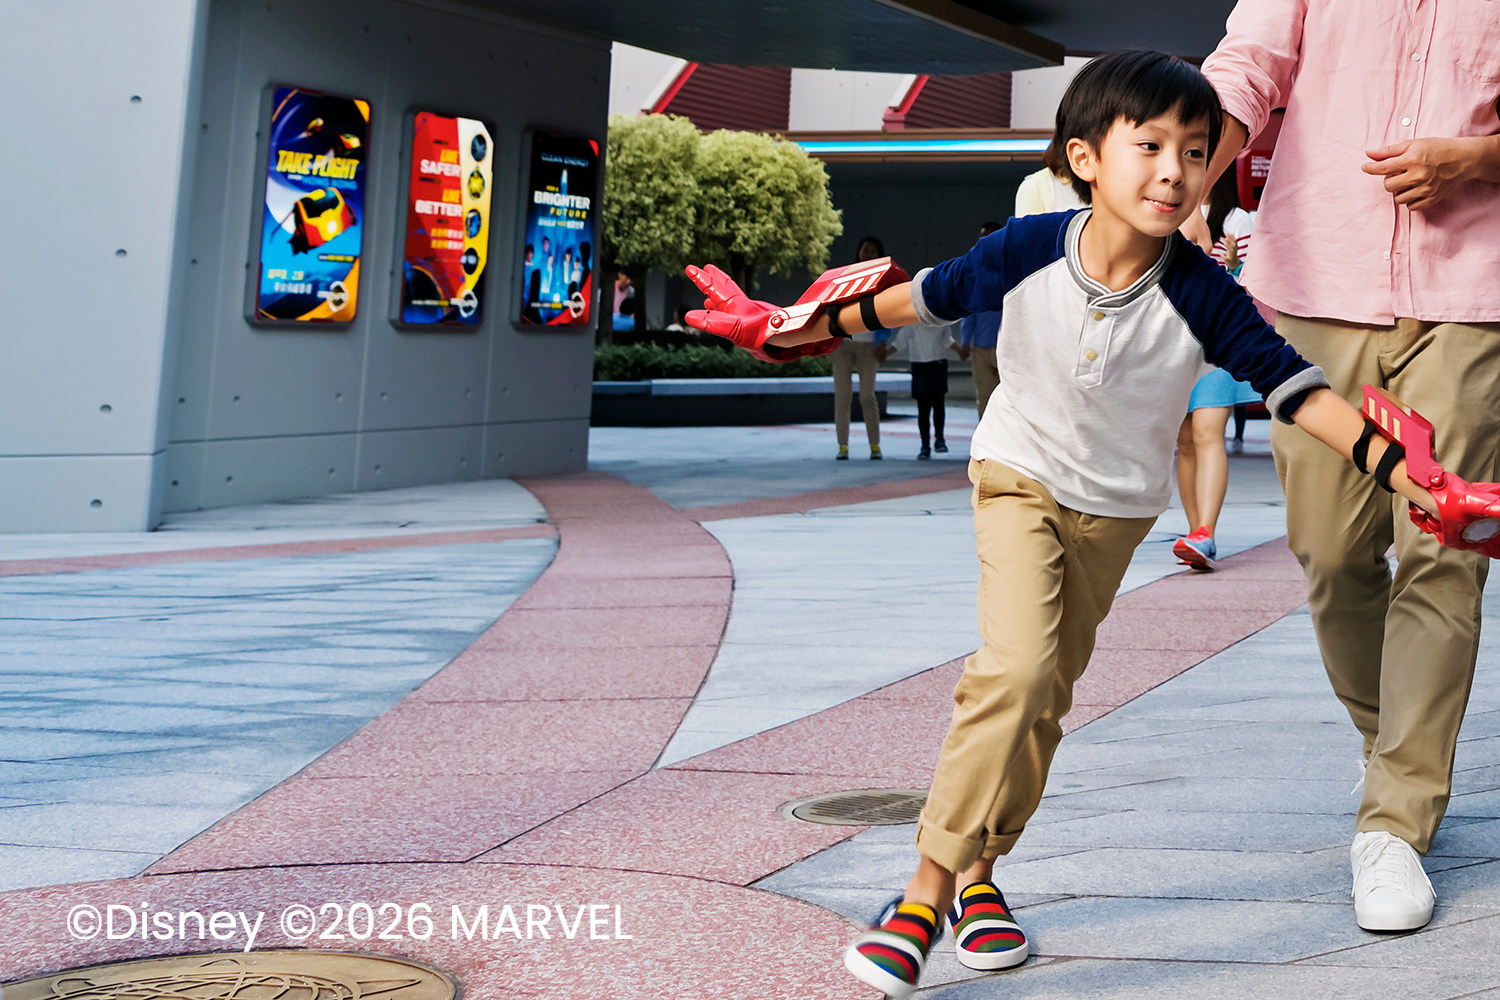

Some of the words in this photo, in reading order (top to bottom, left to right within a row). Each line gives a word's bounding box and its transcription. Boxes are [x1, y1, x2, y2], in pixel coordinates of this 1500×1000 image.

[276, 149, 314, 175] TAKE
[311, 153, 360, 180] FLIGHT
[420, 158, 461, 178] SAFER
[415, 199, 463, 218] BETTER
[533, 189, 591, 210] BRIGHTER
[549, 206, 587, 220] FUTURE
